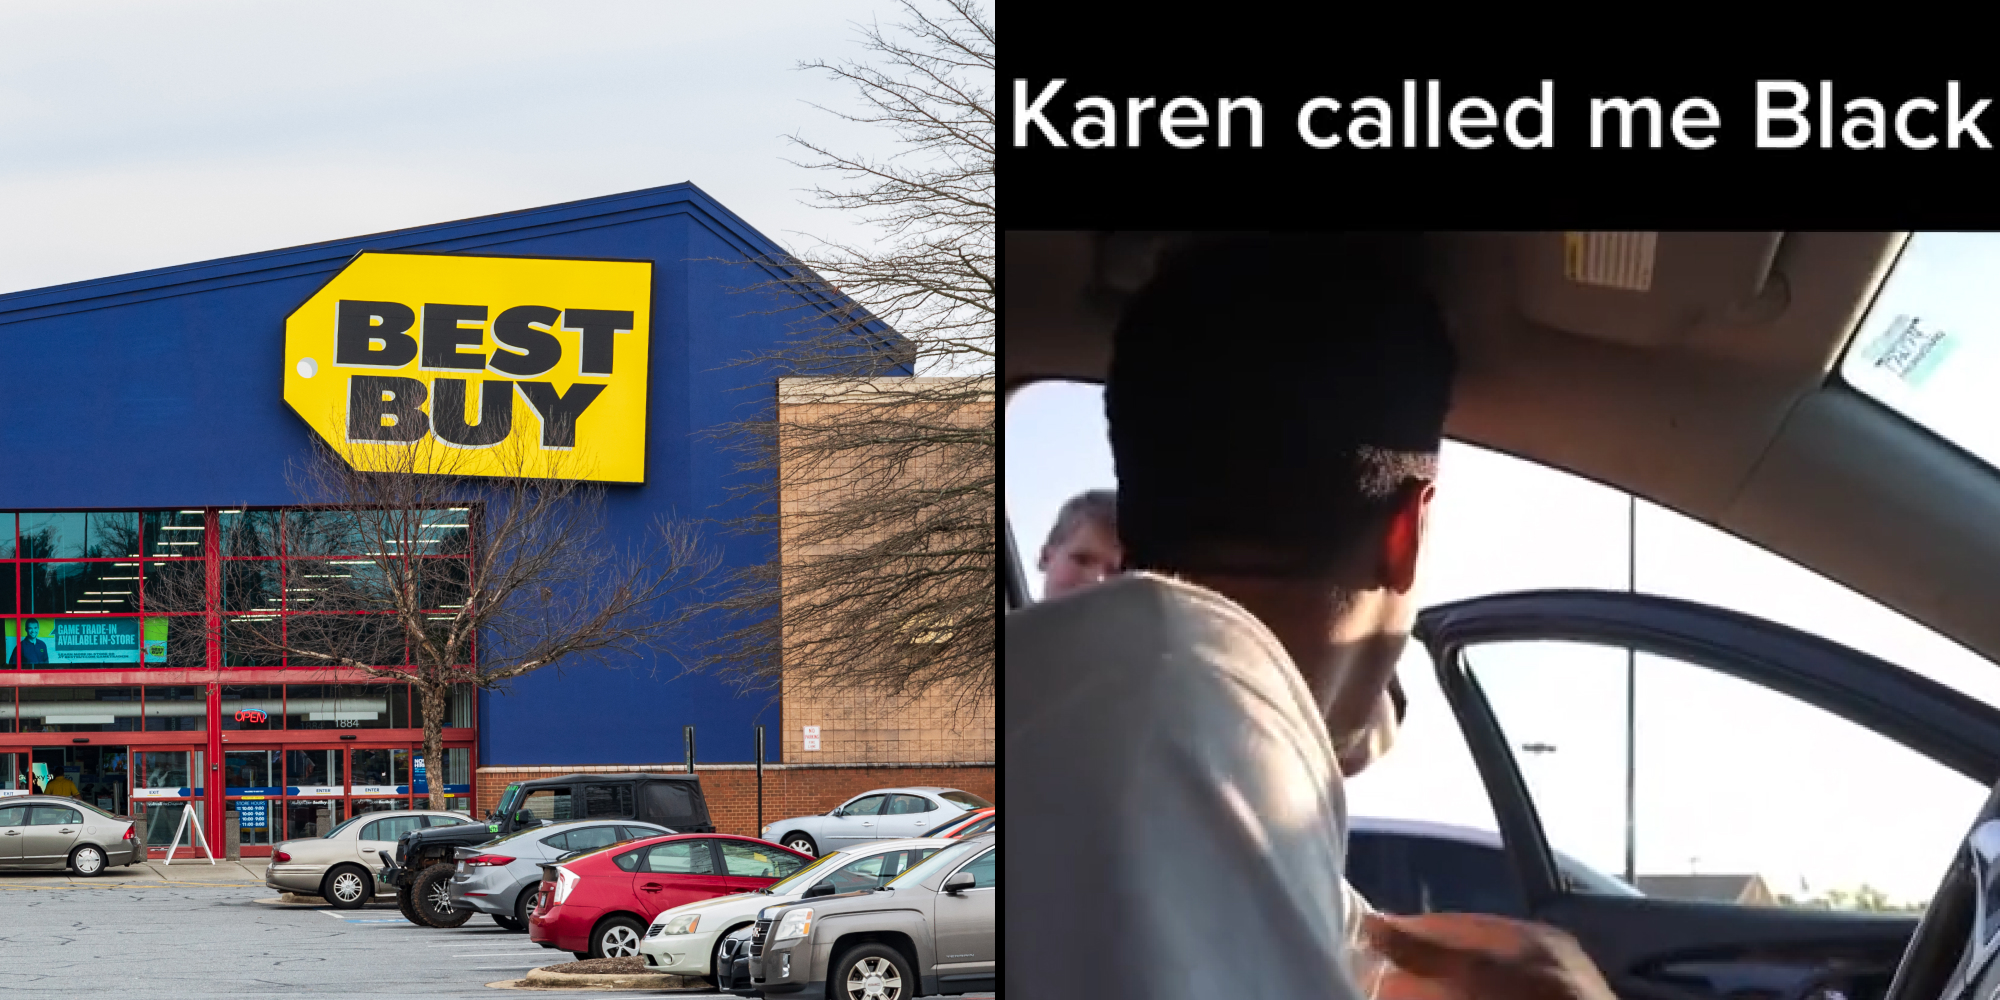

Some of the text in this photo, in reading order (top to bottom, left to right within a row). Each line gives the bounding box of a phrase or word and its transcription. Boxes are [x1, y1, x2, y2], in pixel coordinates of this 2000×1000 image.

[333, 299, 635, 380] BEST
[345, 375, 608, 451] BUY
[58, 624, 118, 635] GAME TRADE-IN
[58, 634, 136, 646] AVAILABLE IN-STORE
[234, 710, 265, 723] OPEN
[335, 719, 360, 728] 1884
